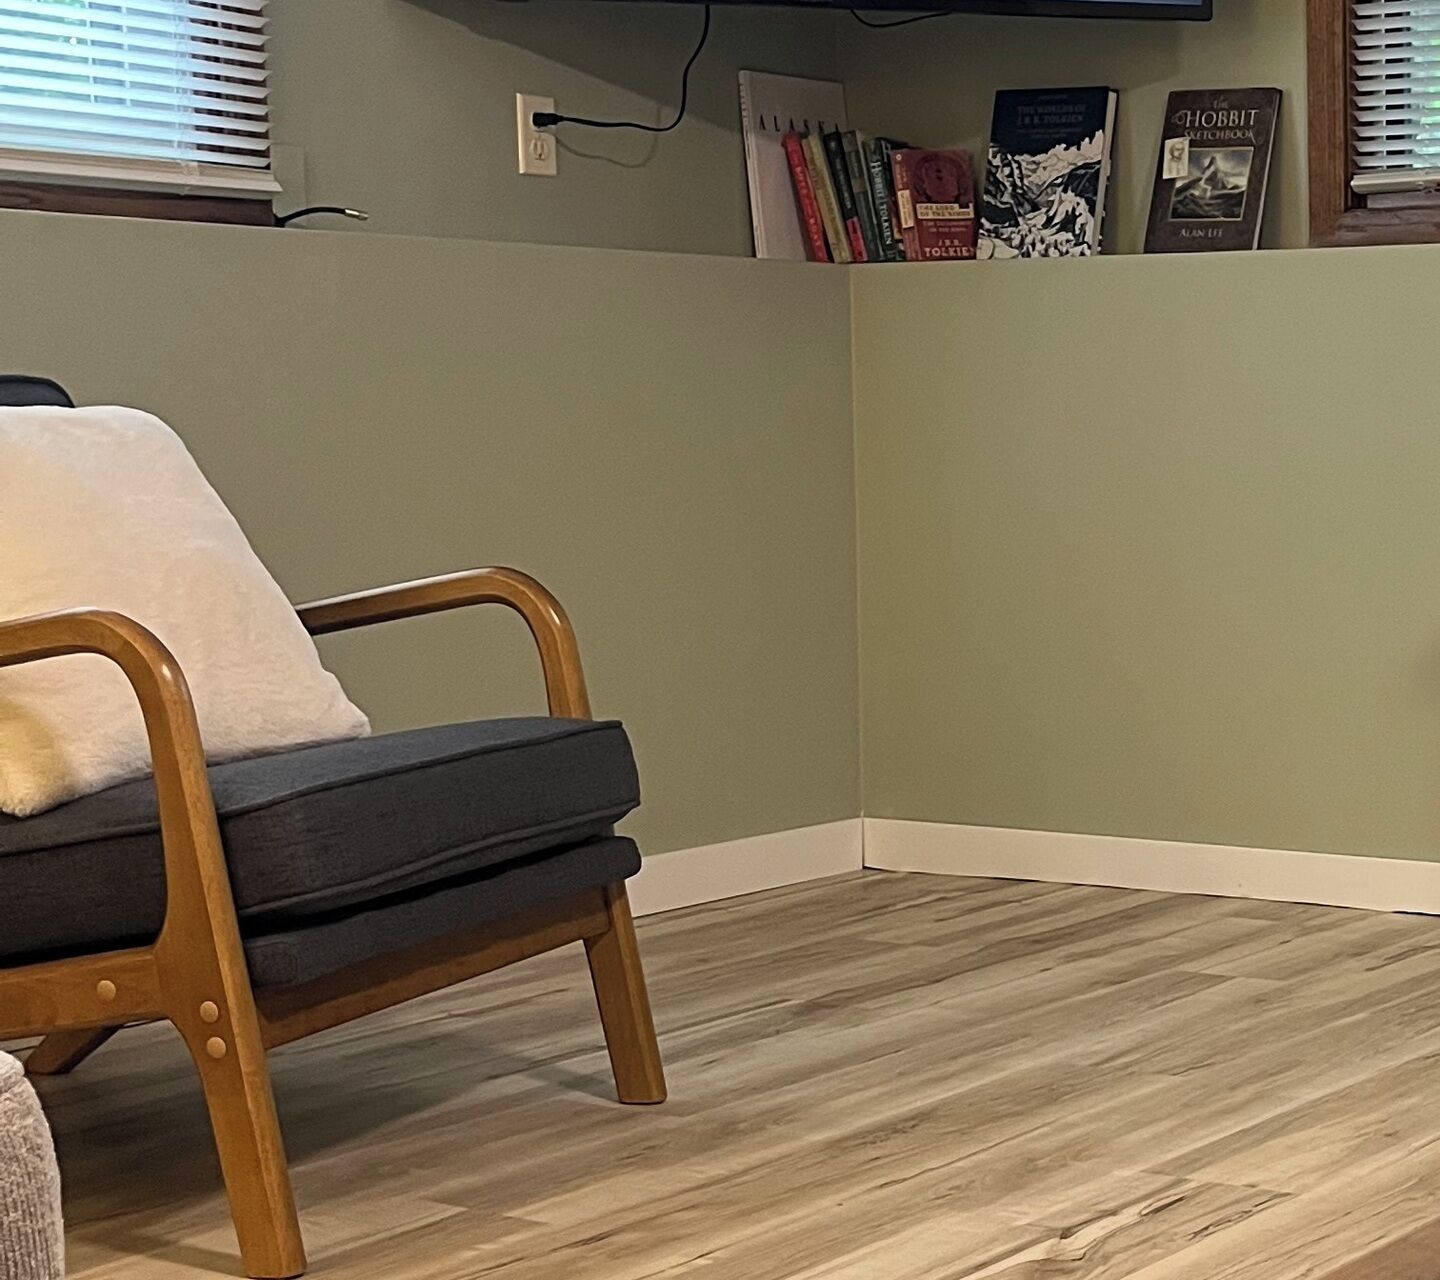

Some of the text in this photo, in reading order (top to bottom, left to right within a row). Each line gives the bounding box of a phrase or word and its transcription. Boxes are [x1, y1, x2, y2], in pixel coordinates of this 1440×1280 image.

[1184, 109, 1260, 128] HOBBIT
[1184, 129, 1256, 142] SKETCHBOOK
[878, 203, 894, 245] TOLKIEN
[1180, 228, 1223, 238] ALAN LEE
